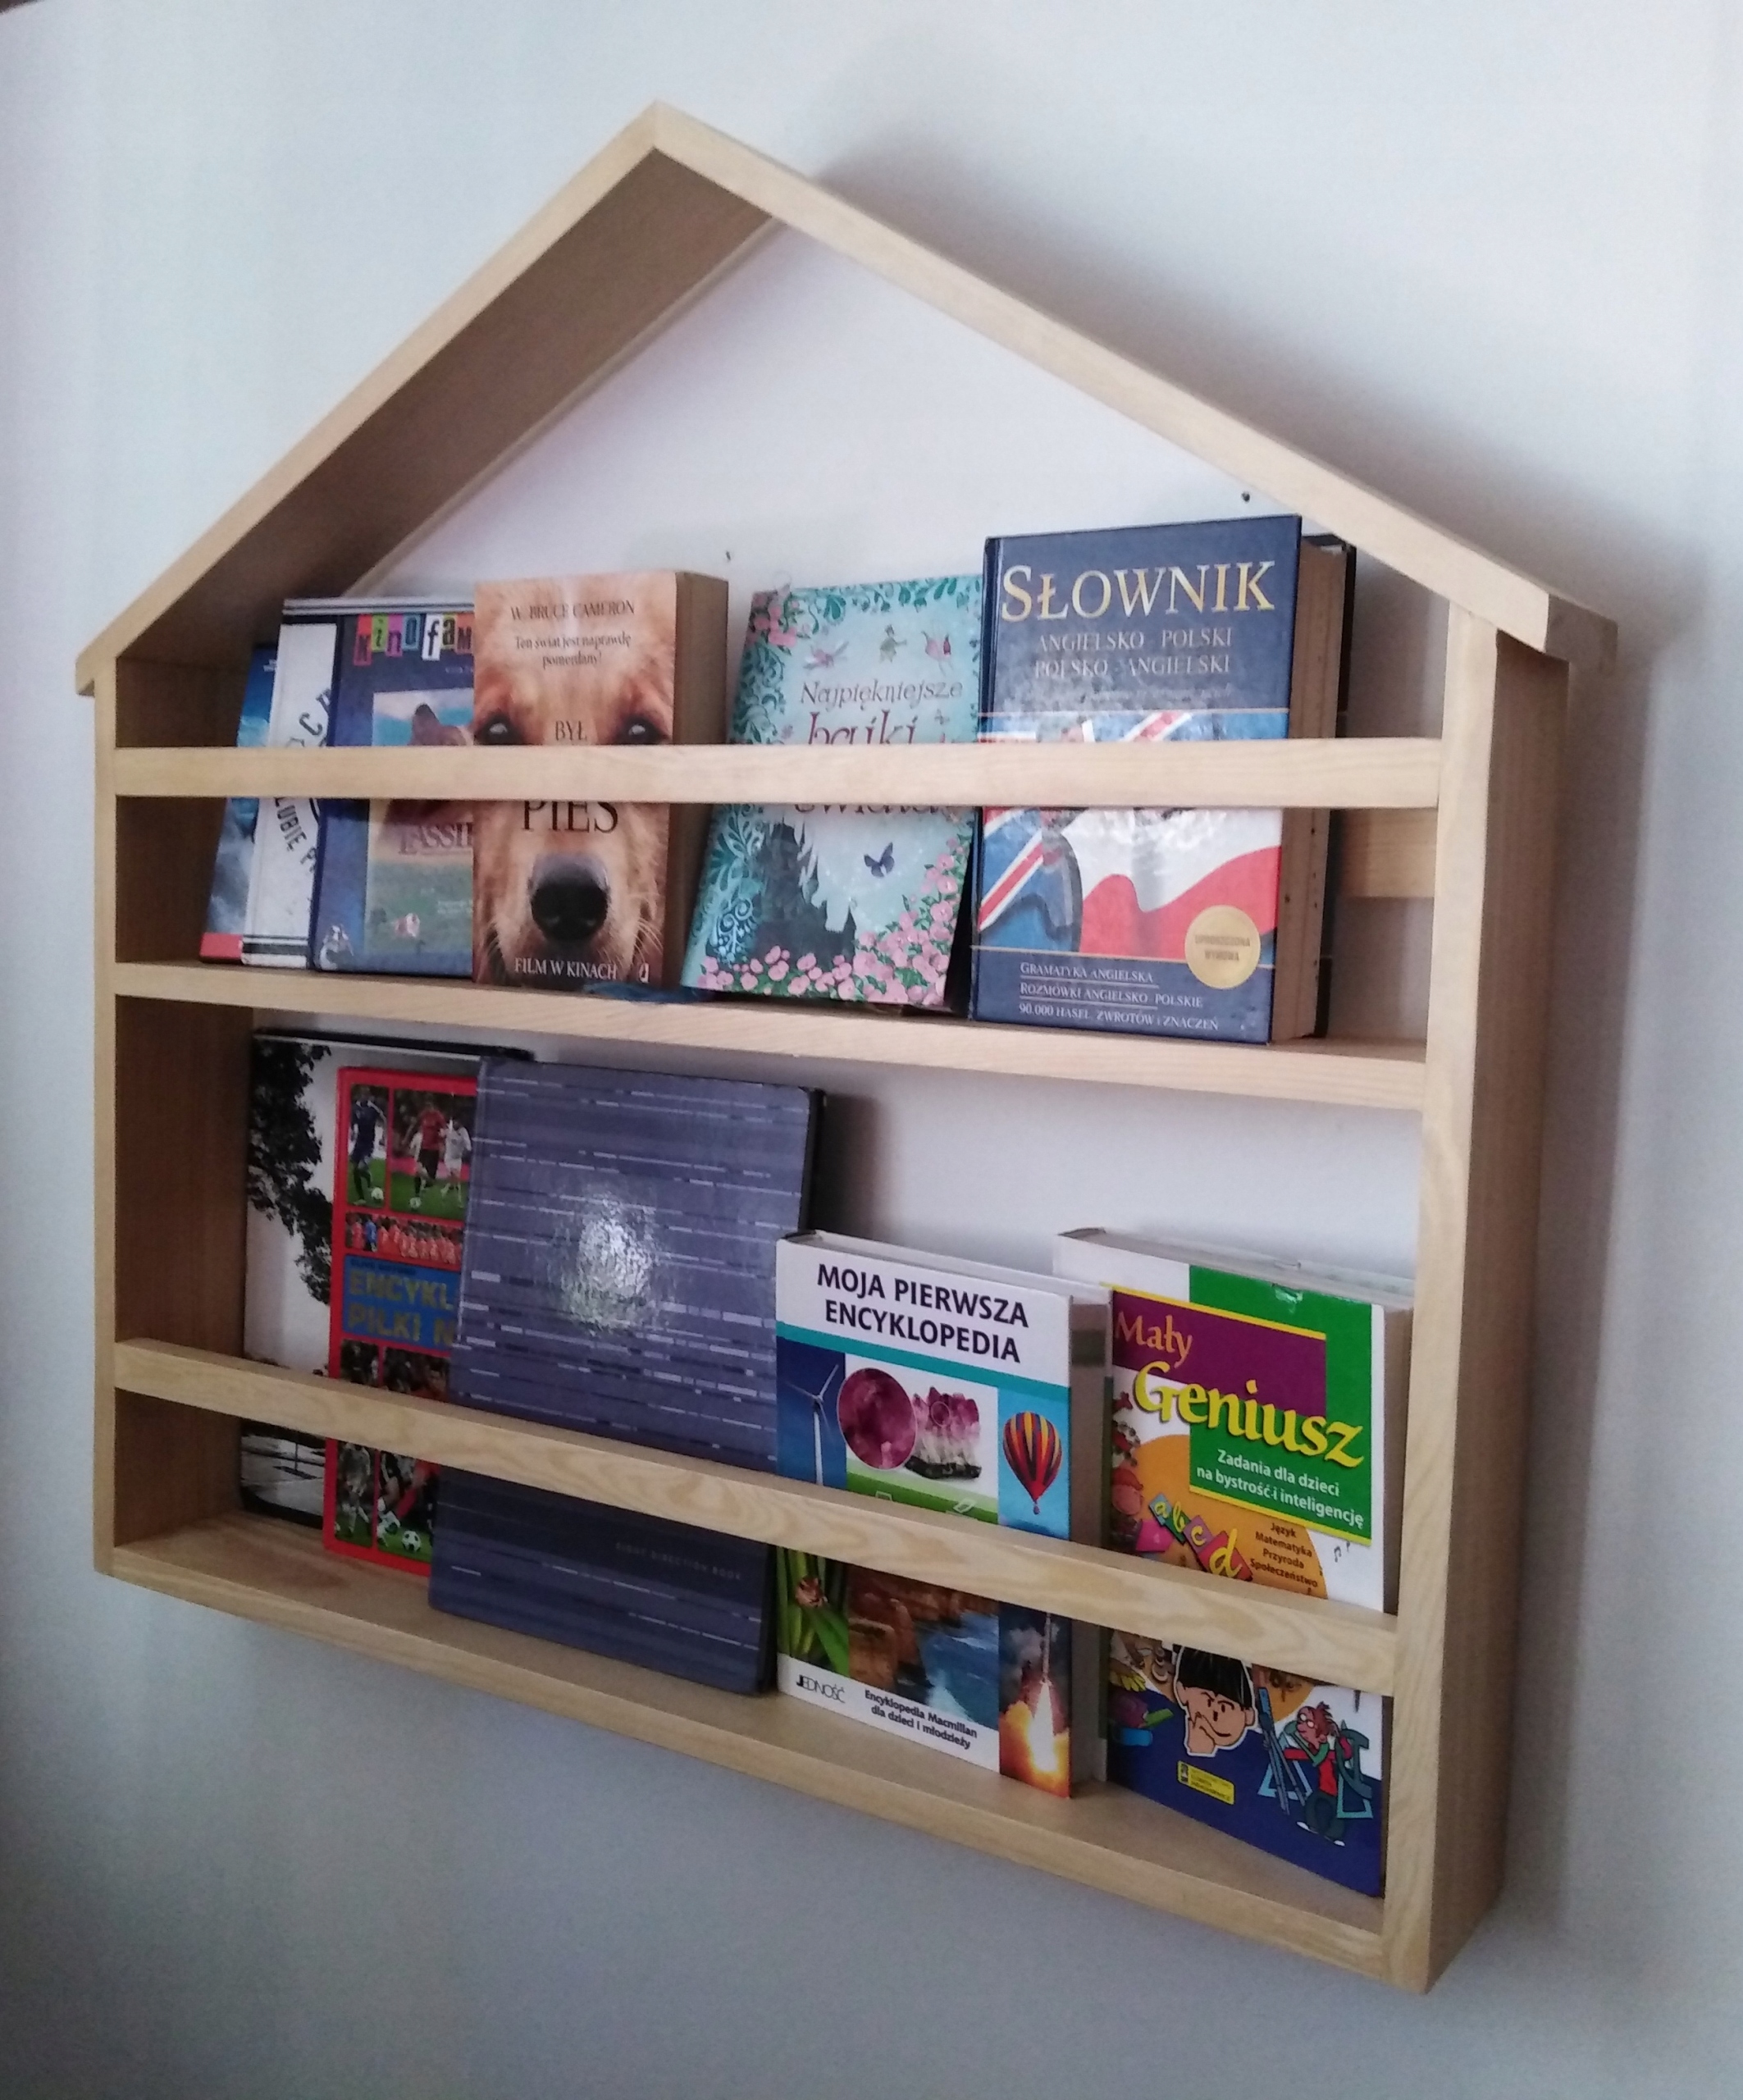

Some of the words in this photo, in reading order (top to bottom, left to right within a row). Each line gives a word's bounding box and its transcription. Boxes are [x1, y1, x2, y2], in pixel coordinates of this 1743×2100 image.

[1002, 560, 1275, 622] SŁOWNIK
[573, 599, 635, 619] CAMERON
[1039, 631, 1145, 652] ANGIELSKO
[1161, 627, 1232, 648] POLSKI
[1034, 658, 1109, 679] POLSKO
[1127, 655, 1230, 677] ANGIELSKI
[801, 678, 964, 712] Najpiękniejsze
[522, 801, 619, 833] PIES
[513, 956, 547, 975] FILM
[549, 959, 565, 976] W
[566, 961, 618, 980] KINACH
[1020, 961, 1087, 979] GRAMATYKA
[1089, 967, 1154, 984] ANGIELSKA
[1020, 981, 1081, 999] ROZMÓWKI
[1083, 988, 1149, 1004] ANGIELSKO
[1154, 993, 1204, 1009] POLSKIE
[1019, 1002, 1054, 1016] 90.000
[1096, 1009, 1155, 1025] ZWROTÓW
[1162, 1014, 1220, 1031] ZNACZEŃ
[817, 1263, 886, 1299] MOJA
[894, 1277, 1029, 1329] PIERWSZA
[824, 1299, 1020, 1363] ENCYKLOPEDIA
[1115, 1311, 1193, 1368] Mały
[1134, 1360, 1365, 1469] Geniusz
[1217, 1449, 1271, 1477] Zadania
[1274, 1466, 1296, 1485] dla
[1298, 1473, 1340, 1498] dzieci
[1196, 1467, 1213, 1481] na
[1215, 1468, 1271, 1499] bystrość
[1280, 1488, 1365, 1530] inteligencję
[1255, 1531, 1312, 1558] Matematyka
[1270, 1522, 1297, 1538] Język
[1249, 1557, 1318, 1588] Społeczeństwo
[1262, 1547, 1305, 1569] Przyroda
[796, 1674, 846, 1704] JEDNOŚĆ
[864, 1689, 925, 1719] Encyklopedia
[928, 1712, 978, 1738] Macmillan
[871, 1705, 886, 1719] dla
[887, 1711, 915, 1730] dzieci
[923, 1723, 971, 1750] młodzieży
